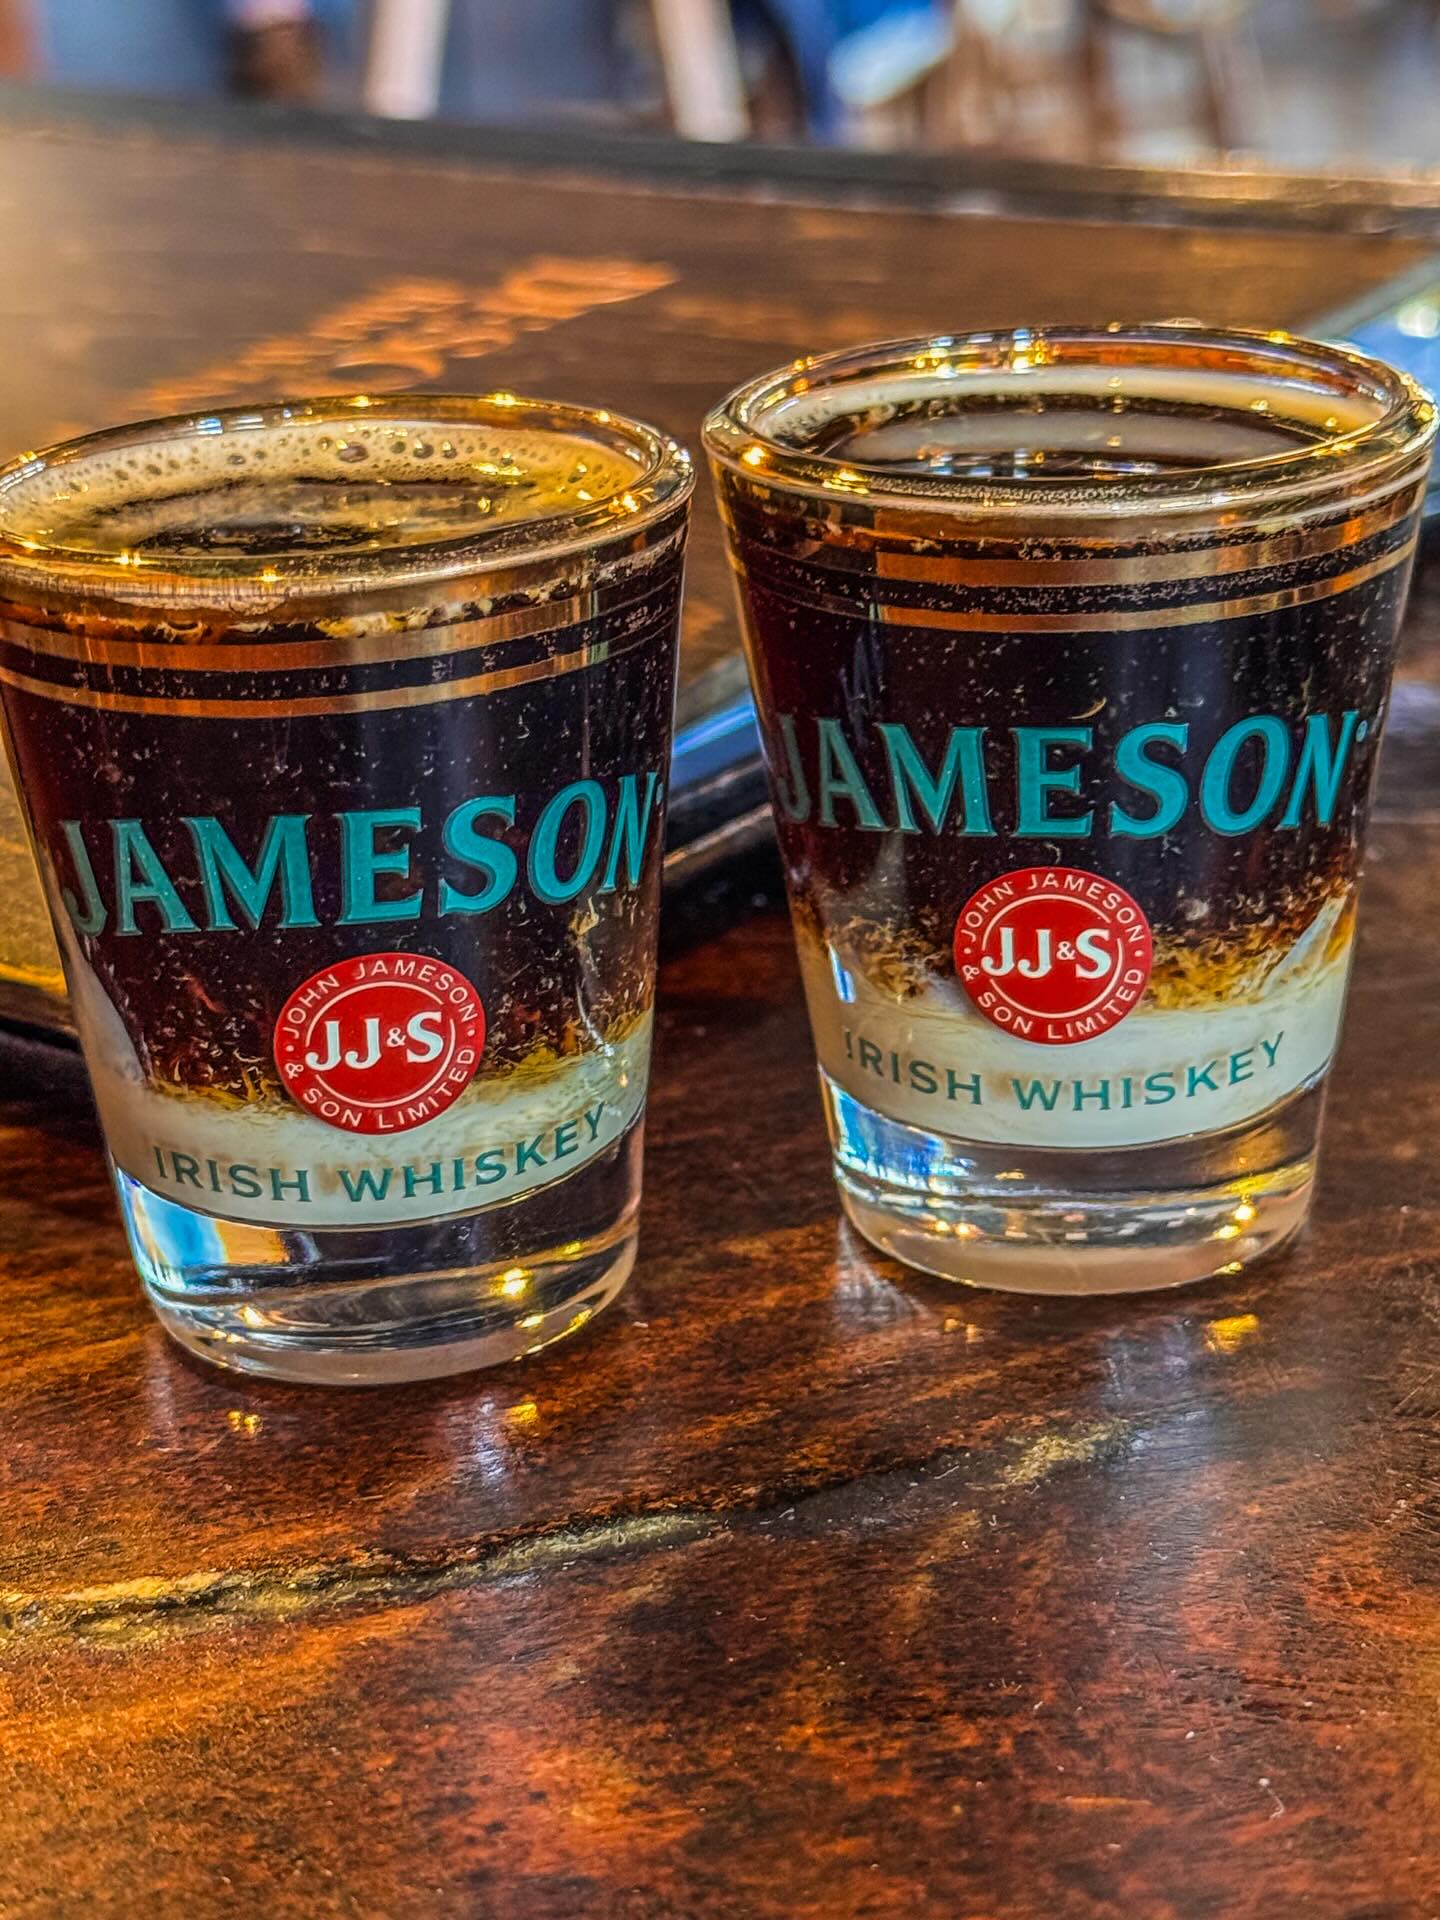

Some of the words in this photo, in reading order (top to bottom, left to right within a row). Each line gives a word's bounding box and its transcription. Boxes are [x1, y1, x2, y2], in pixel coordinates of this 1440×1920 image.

[777, 710, 1358, 838] JAMESON
[60, 772, 657, 937] JAMESON
[961, 881, 1014, 942] JOHN
[1027, 873, 1145, 943] JAMESON
[981, 927, 1112, 979] JJ&S
[282, 974, 340, 1039] JOHN
[352, 960, 478, 1022] JAMESON
[962, 965, 980, 981] &
[978, 992, 1033, 1034] SON
[1048, 969, 1144, 1039] LIMITED
[305, 1011, 444, 1071] JJ&S
[844, 1029, 982, 1105] IRISH
[1012, 1031, 1284, 1112] WHISKEY
[284, 1062, 304, 1079] &
[303, 1087, 362, 1127] SON
[378, 1049, 475, 1129] LIMITED
[153, 1146, 311, 1203] IRISH
[338, 1102, 603, 1203] WHISKEY
